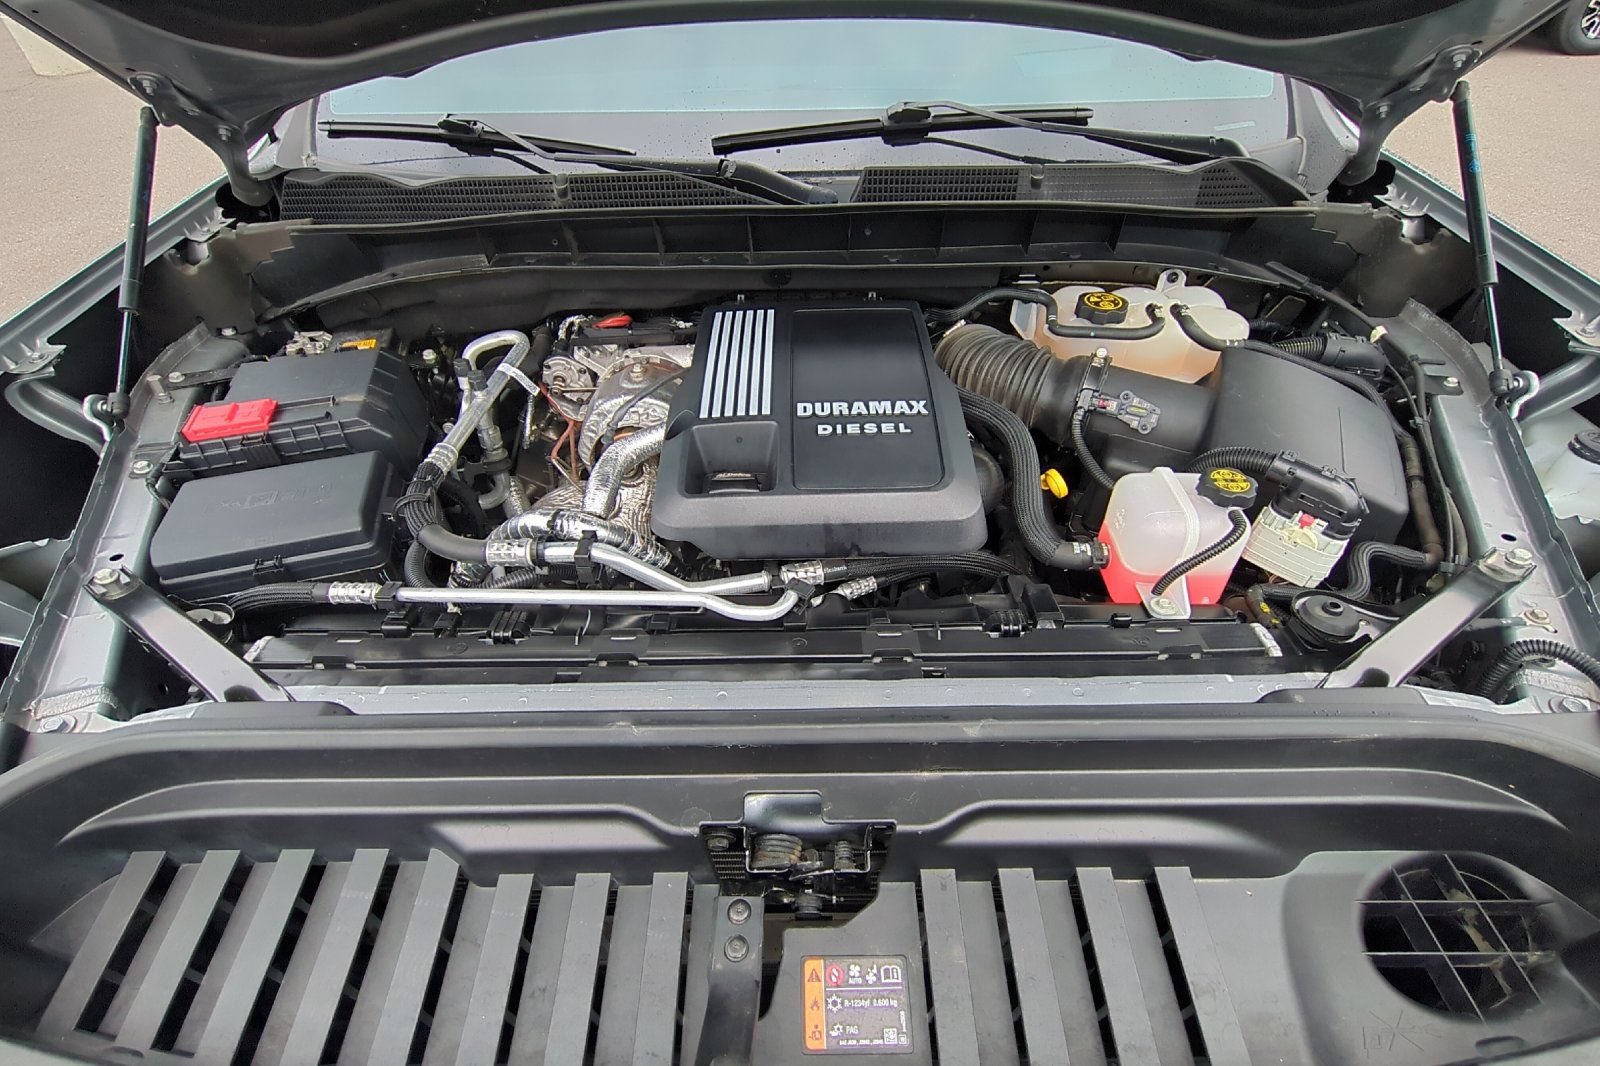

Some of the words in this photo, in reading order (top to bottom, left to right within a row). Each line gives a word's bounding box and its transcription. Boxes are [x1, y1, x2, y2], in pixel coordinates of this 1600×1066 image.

[797, 400, 928, 417] DURAMAX
[817, 423, 911, 436] DIESEL
[844, 999, 870, 1008] R-1234yf
[889, 998, 898, 1008] kg
[845, 1025, 859, 1034] PAG
